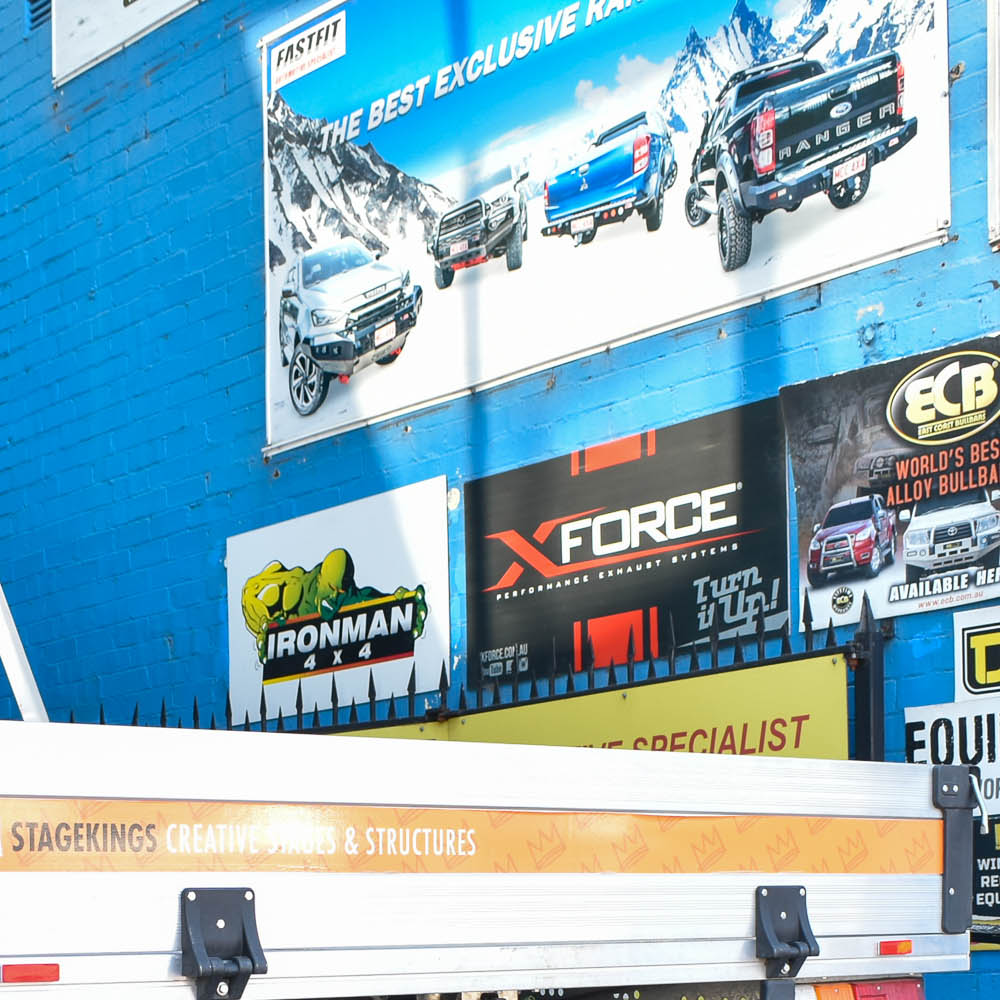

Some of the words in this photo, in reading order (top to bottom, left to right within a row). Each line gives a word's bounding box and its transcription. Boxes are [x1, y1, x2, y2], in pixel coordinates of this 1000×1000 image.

[276, 18, 341, 67] FASTFIT
[320, 107, 364, 152] THE
[367, 75, 430, 132] BEST
[433, 2, 580, 100] EXCLUSIVE
[585, 0, 644, 27] RA
[778, 102, 896, 160] RANGER
[904, 361, 998, 425] ECB
[933, 421, 954, 433] COAST
[895, 446, 964, 480] WORLD'S
[886, 478, 938, 506] ALLOY
[482, 482, 738, 592] XFORCE
[496, 574, 589, 600] PERFORMANCE
[599, 559, 662, 580] EXHAUST
[671, 542, 738, 564] SYSTEMS
[693, 565, 763, 604] Turn
[889, 572, 969, 602] AVAILABLE
[267, 603, 414, 660] IRONMAN
[304, 653, 317, 671] 4
[358, 642, 372, 660] 4
[10, 821, 157, 853] STAGEKINGS
[166, 822, 260, 855] CREATIVE
[266, 824, 337, 856] SAGES
[344, 827, 359, 856] &
[366, 827, 476, 857] STRUCTURES
